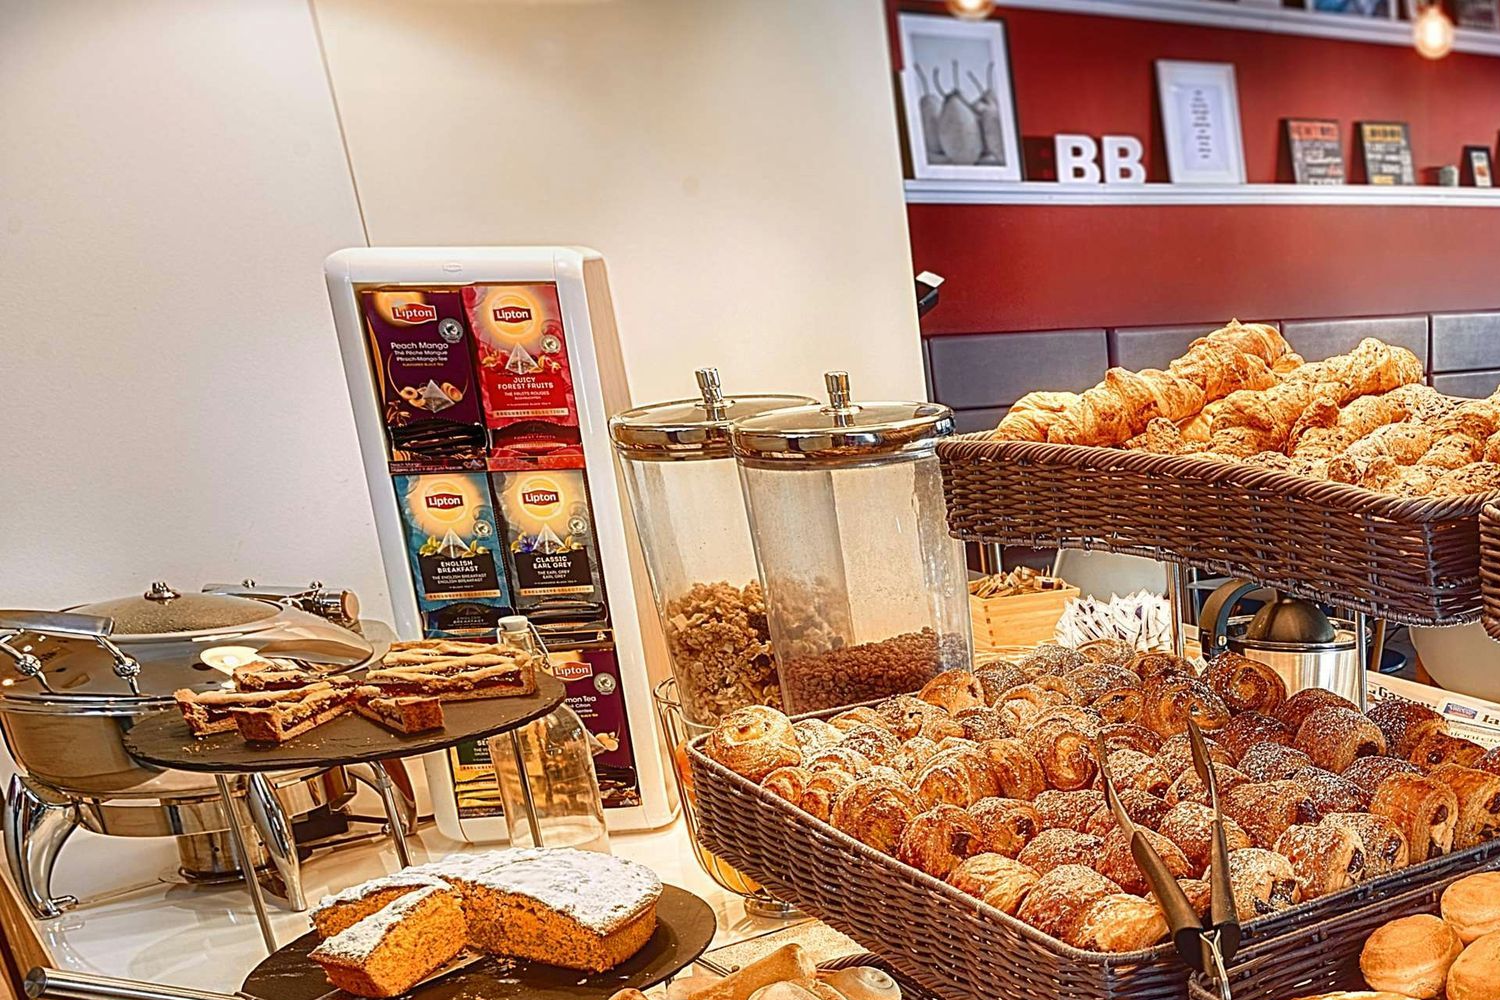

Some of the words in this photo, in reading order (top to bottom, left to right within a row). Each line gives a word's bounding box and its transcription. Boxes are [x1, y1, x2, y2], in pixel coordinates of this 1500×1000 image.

[394, 307, 433, 319] Lipton
[496, 308, 529, 321] Lipton
[390, 342, 418, 350] Peach
[418, 342, 449, 350] Mango
[428, 495, 461, 507] Lipton
[525, 492, 557, 504] Lipton
[535, 555, 568, 563] CLASSIC
[437, 565, 479, 573] BREAKFAST
[555, 666, 589, 677] Lipton
[1482, 714, 1500, 726] la
